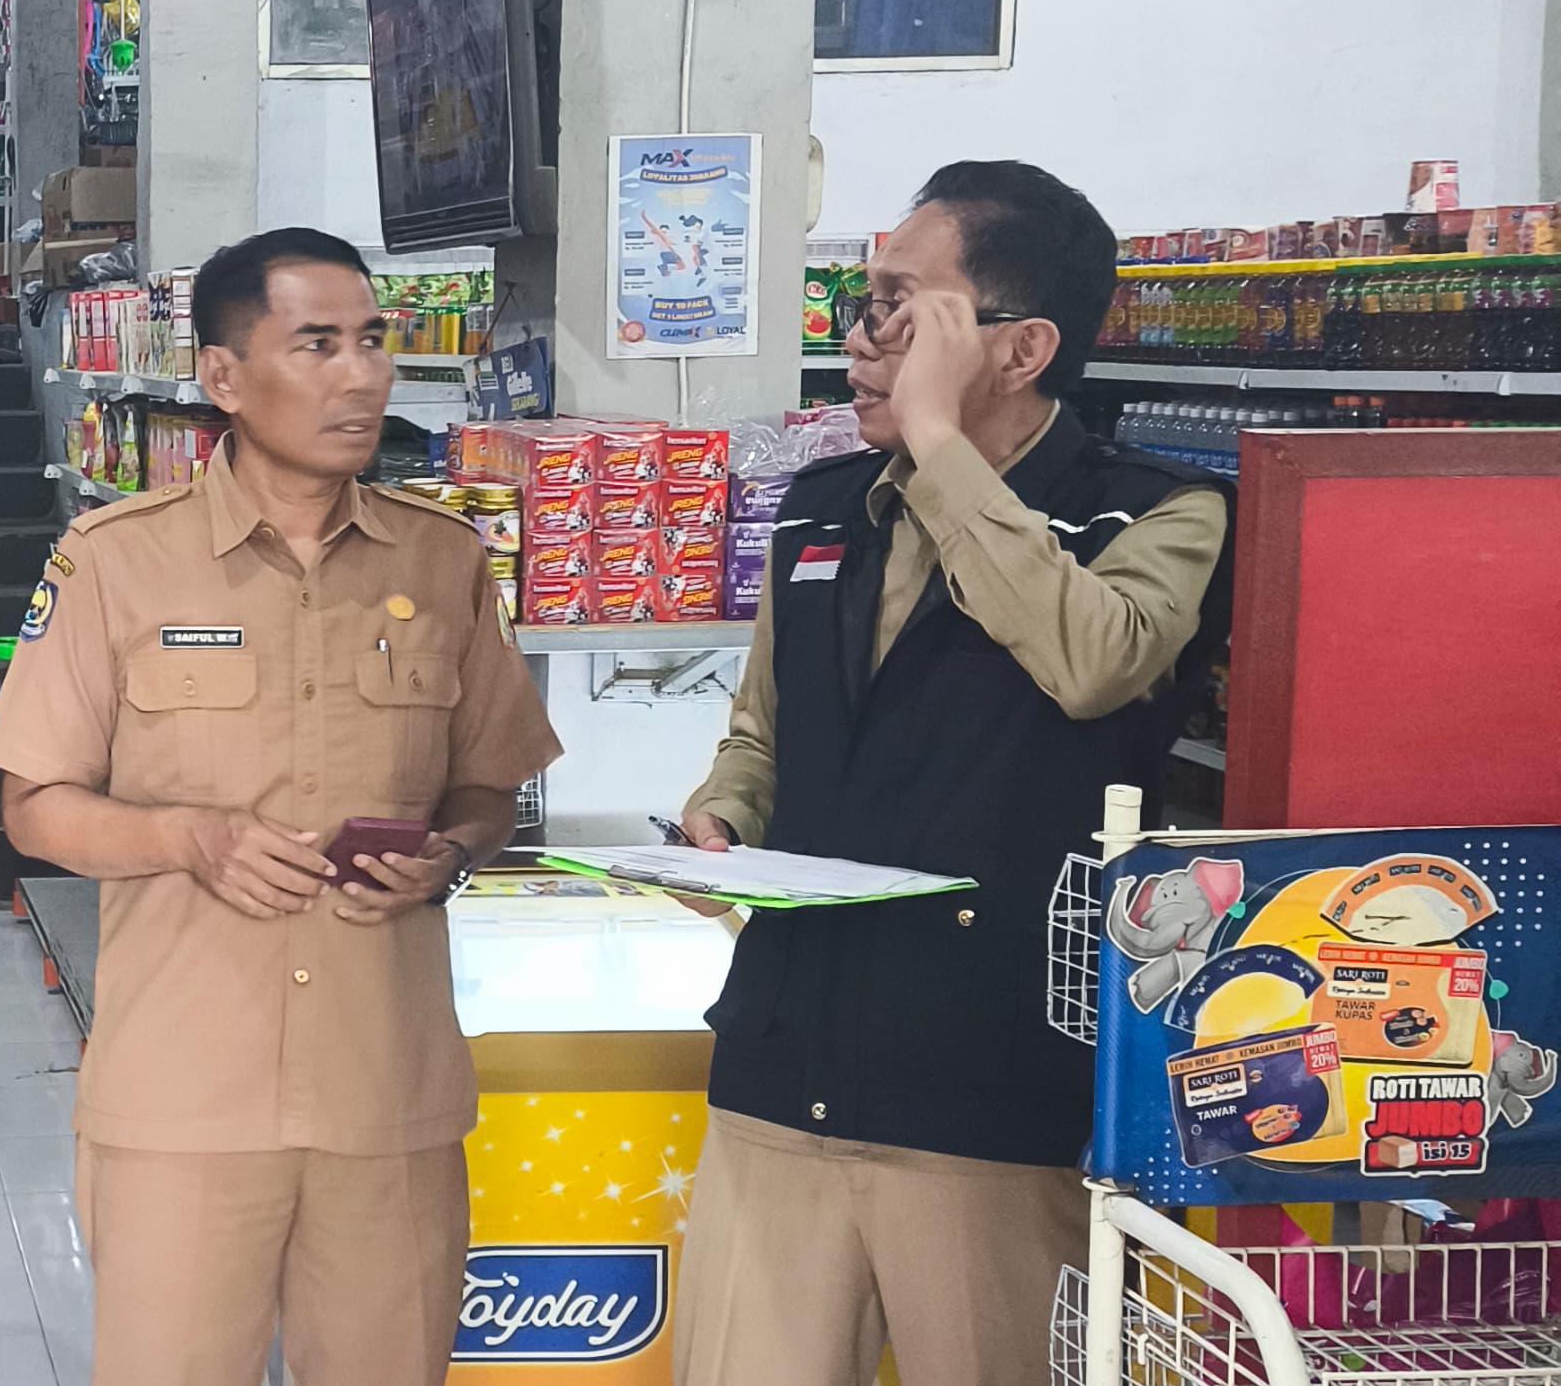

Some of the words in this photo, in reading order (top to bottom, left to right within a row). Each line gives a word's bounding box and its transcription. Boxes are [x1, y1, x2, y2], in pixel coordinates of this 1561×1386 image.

[640, 149, 693, 168] MAX
[174, 633, 215, 643] SAIFUL
[1336, 969, 1359, 980] SARI
[1360, 970, 1386, 980] ROTI
[1452, 978, 1480, 993] 20%
[1335, 1000, 1376, 1011] TAWAR
[1335, 1010, 1373, 1021] KUPAS
[1311, 1053, 1337, 1069] 20%
[1190, 1076, 1213, 1089] SARI
[1214, 1070, 1239, 1084] ROTI
[1372, 1077, 1417, 1100] ROTI
[1418, 1076, 1482, 1100] TAWAR
[1196, 1105, 1238, 1122] TAWAR
[1366, 1100, 1484, 1137] JUMBO
[1423, 1142, 1447, 1160] isi
[1450, 1143, 1472, 1159] 15
